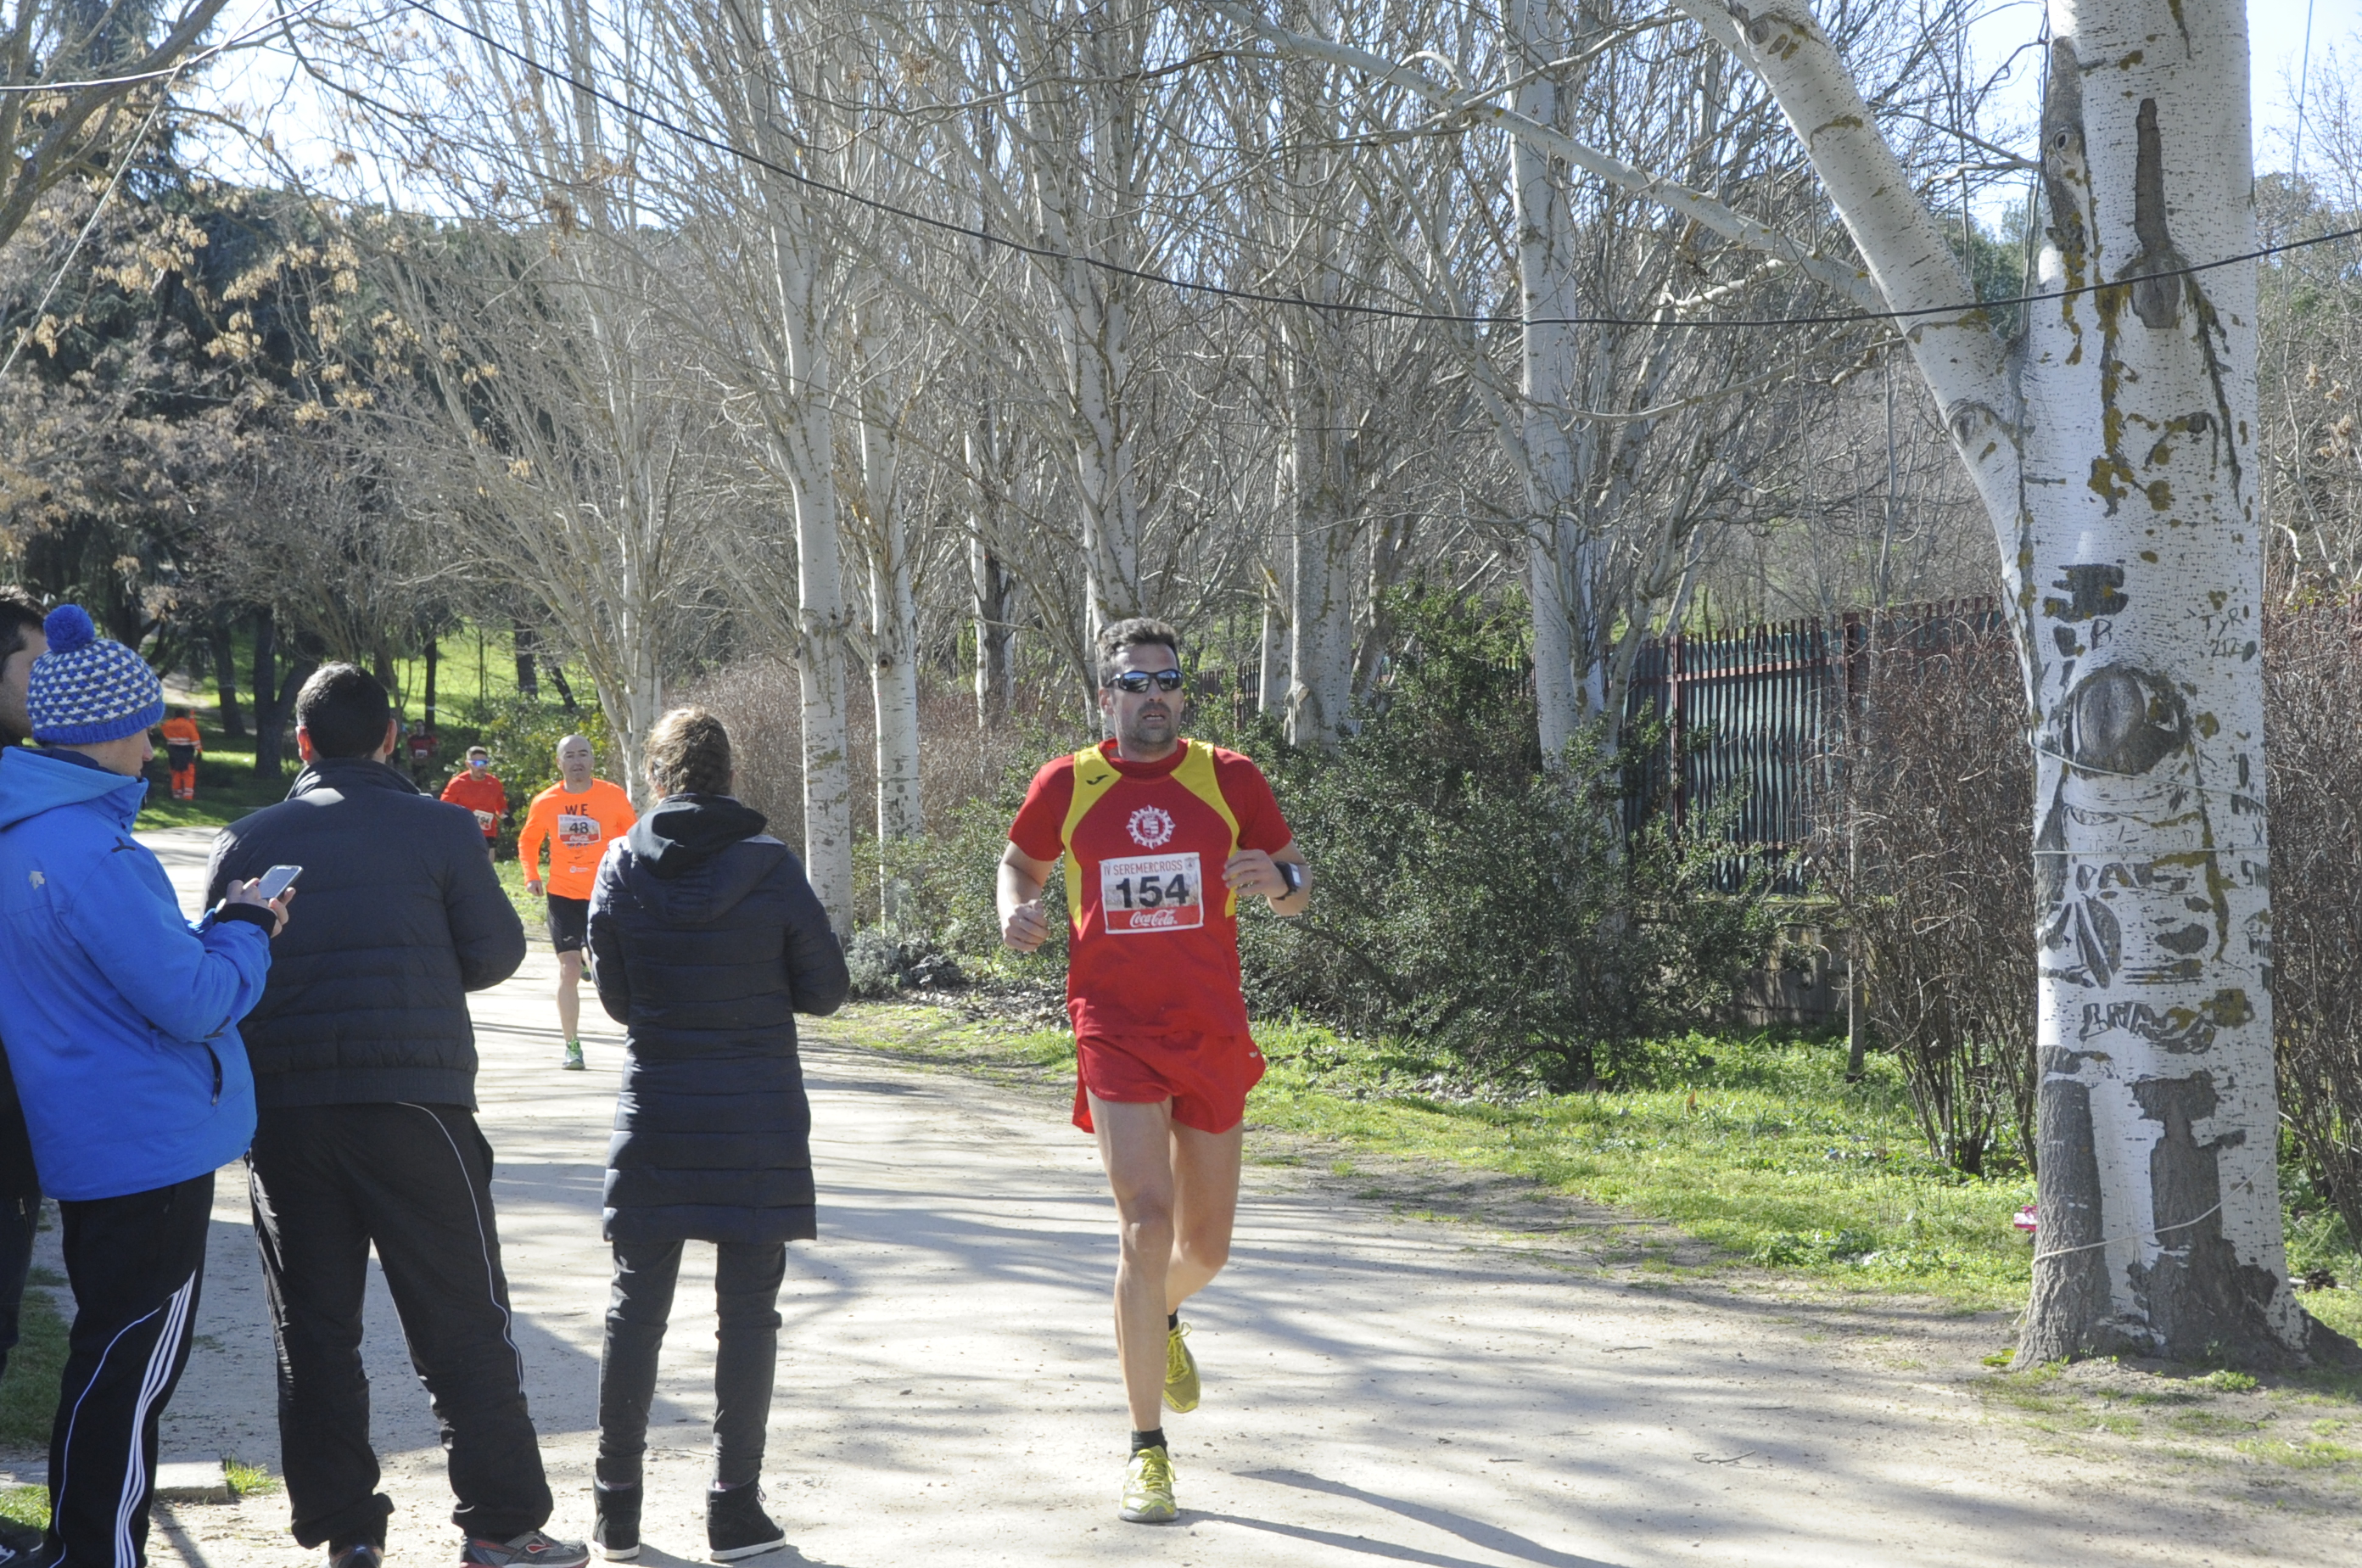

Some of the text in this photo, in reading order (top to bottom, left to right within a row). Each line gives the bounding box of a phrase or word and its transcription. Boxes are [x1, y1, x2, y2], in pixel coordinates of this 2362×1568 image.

[565, 804, 588, 816] WE
[569, 821, 589, 834] 48
[1113, 860, 1183, 876] SEREMERCROSS
[1116, 873, 1189, 909] 154
